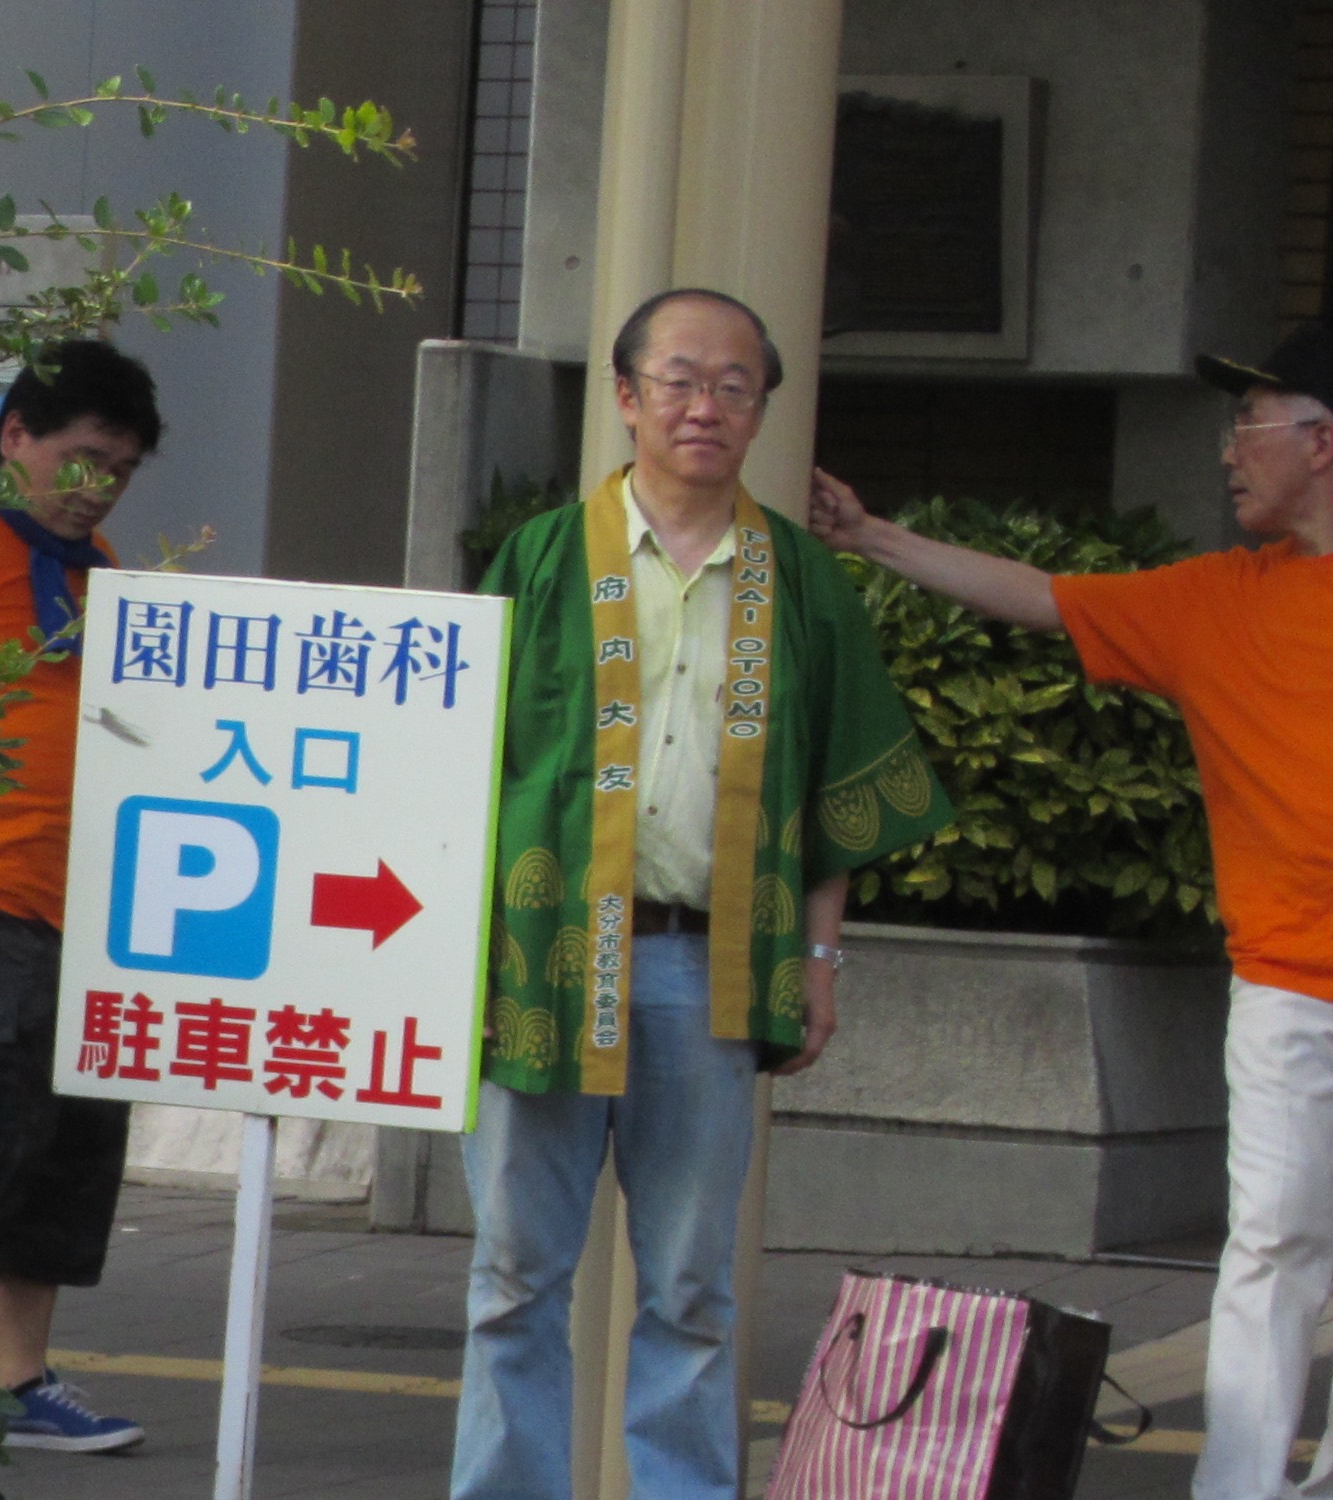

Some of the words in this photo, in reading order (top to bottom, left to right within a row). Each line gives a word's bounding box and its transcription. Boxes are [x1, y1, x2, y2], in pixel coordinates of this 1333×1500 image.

[735, 526, 770, 624] FUNAI
[111, 596, 471, 710] 園田歯科
[591, 575, 637, 792] 府内大友
[728, 638, 767, 738] OTOMO
[199, 718, 360, 794] 入口
[128, 808, 261, 957] P
[593, 892, 624, 1048] 大分市教育委員会
[76, 989, 443, 1110] 駐車禁止
